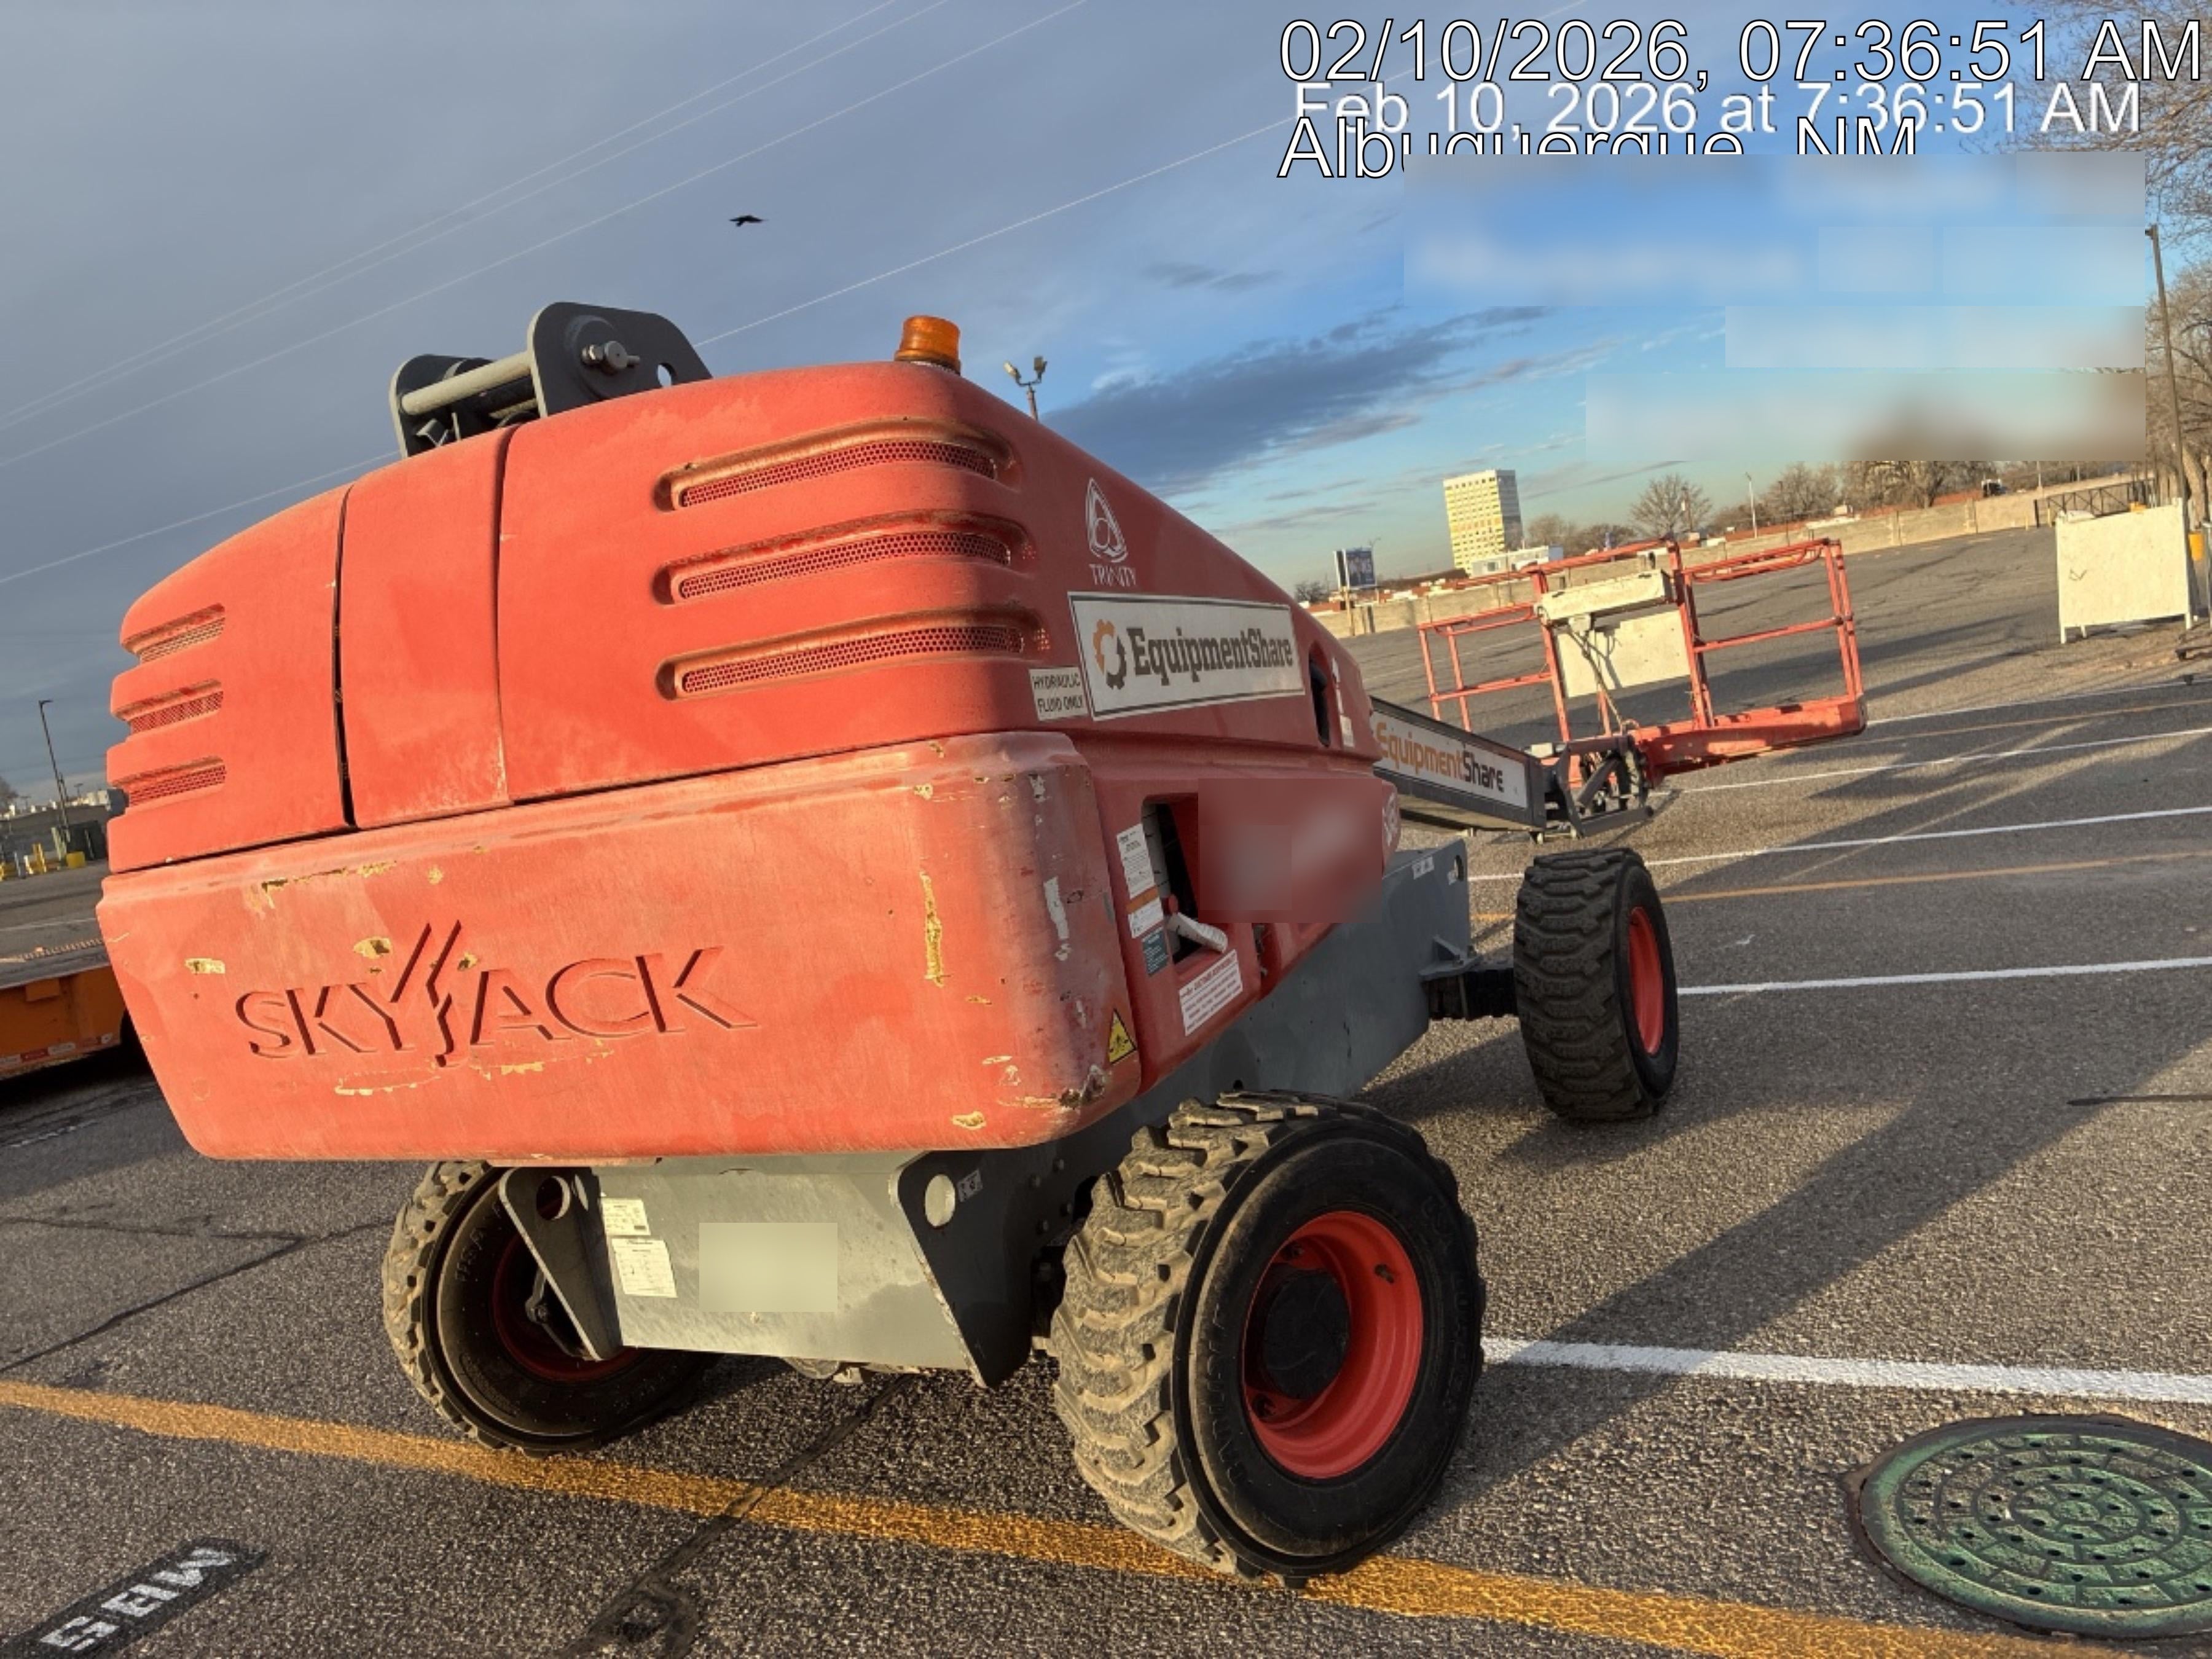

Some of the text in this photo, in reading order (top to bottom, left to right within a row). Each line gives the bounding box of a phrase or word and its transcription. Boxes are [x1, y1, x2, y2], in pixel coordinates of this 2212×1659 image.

[1126, 626, 1293, 686] EquipmentShare
[1376, 721, 1504, 793] EquipmentShare
[235, 920, 758, 1068] SKYJACK
